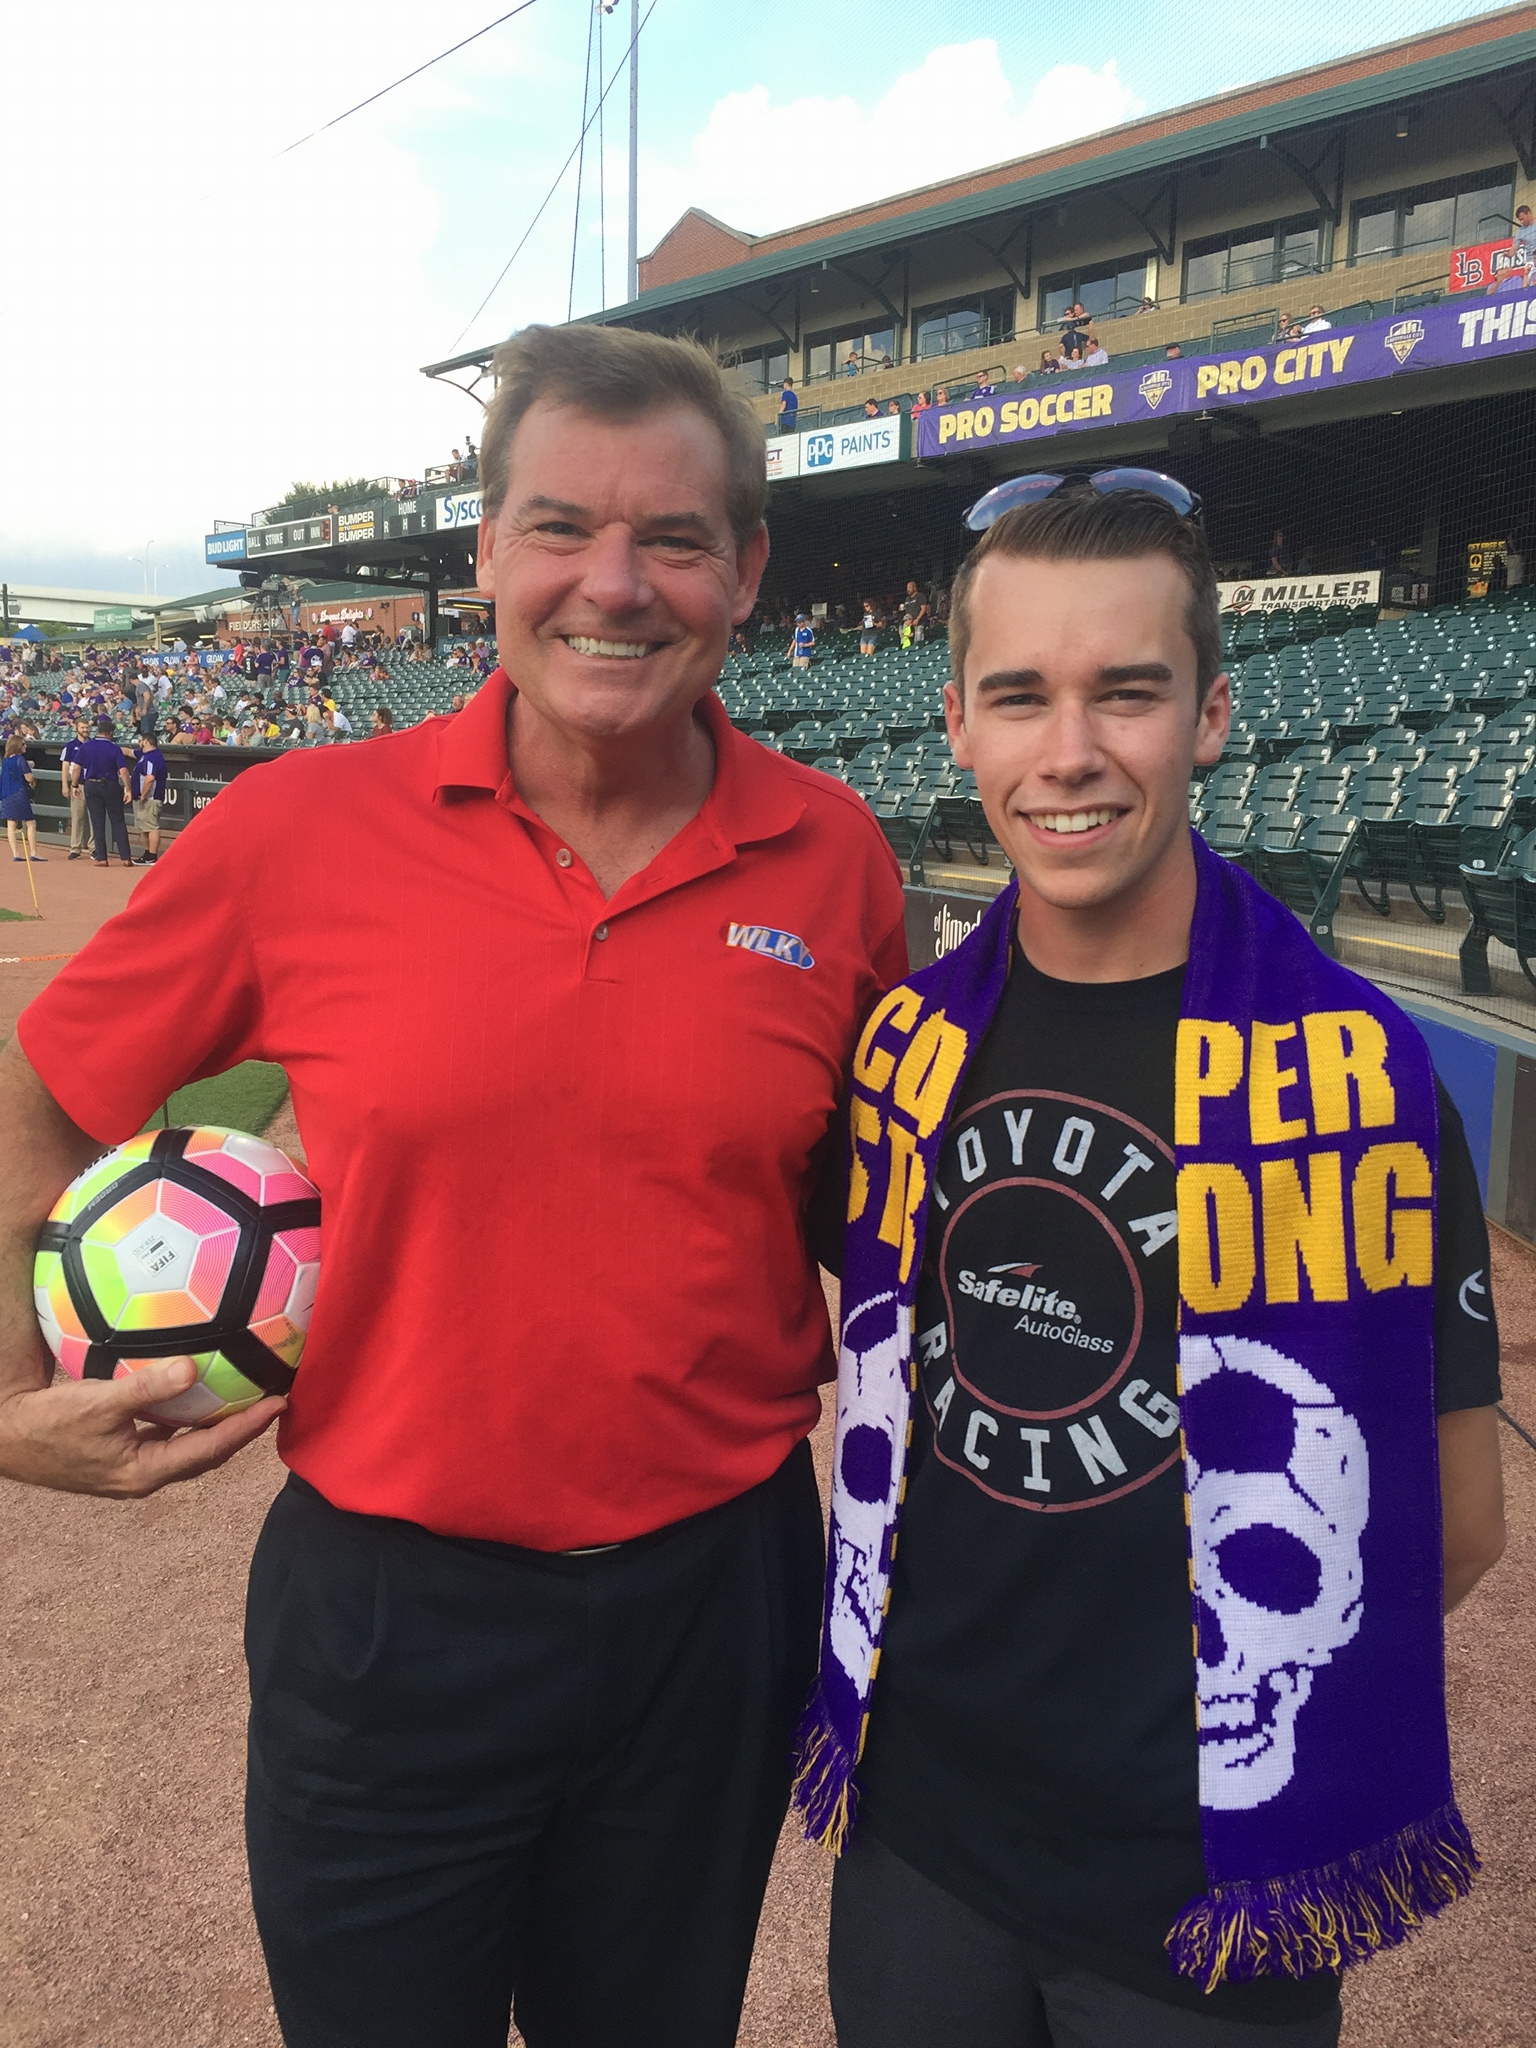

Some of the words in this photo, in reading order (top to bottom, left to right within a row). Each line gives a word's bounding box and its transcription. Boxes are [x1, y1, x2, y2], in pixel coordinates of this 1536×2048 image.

[1197, 355, 1266, 398] PRO
[1273, 335, 1355, 385] CITY
[939, 406, 994, 444] PRO
[1000, 384, 1113, 433] SOCCER
[808, 438, 832, 464] PPG
[841, 431, 890, 455] PAINTS
[338, 511, 374, 526] BUMPER
[399, 501, 417, 515] HOME
[248, 536, 260, 548] BALL
[265, 532, 283, 546] STRIKE
[293, 528, 304, 541] OUT
[338, 528, 374, 542] BUMPER
[384, 521, 389, 533] R
[403, 518, 408, 530] H
[421, 515, 426, 527] E
[207, 542, 222, 554] BUD
[223, 538, 244, 553] LIGHT
[1261, 596, 1367, 610] TRANSPORTATION
[1262, 581, 1371, 602] MILLER
[1174, 1010, 1396, 1146] PER
[88, 1181, 119, 1211] ORDEM
[932, 1107, 1180, 1257] OYOTA
[1176, 1141, 1433, 1314] ONG
[150, 1250, 175, 1272] FIFA
[957, 1269, 1077, 1322] Safelite
[1014, 1314, 1115, 1354] AutoGlass
[917, 1321, 1181, 1493] RACING
